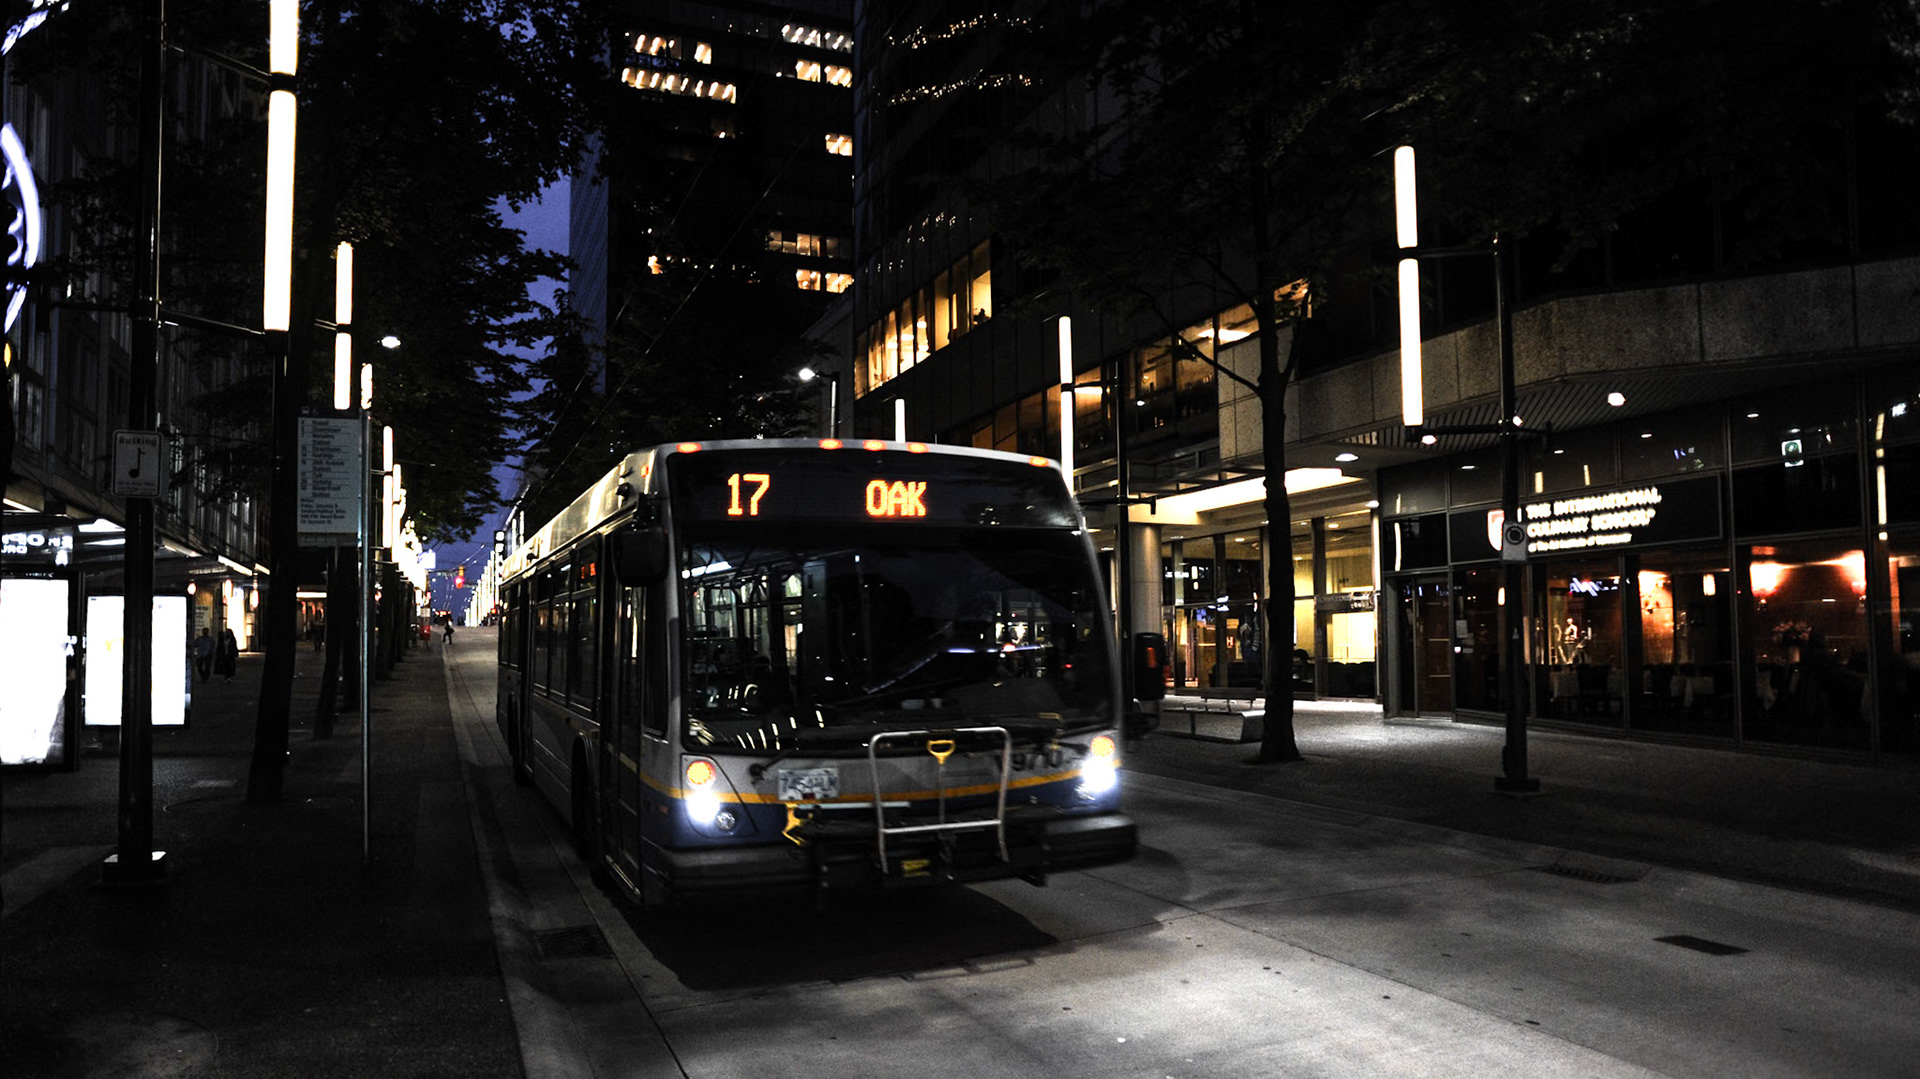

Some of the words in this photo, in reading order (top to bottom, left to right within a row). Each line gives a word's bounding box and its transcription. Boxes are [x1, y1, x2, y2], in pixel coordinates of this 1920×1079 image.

[119, 436, 157, 448] Busking
[727, 473, 770, 516] 17
[866, 480, 927, 517] OAK
[1526, 503, 1551, 519] THE
[1553, 487, 1661, 516] INTERNATIONAL
[1527, 517, 1589, 537] CULINARY
